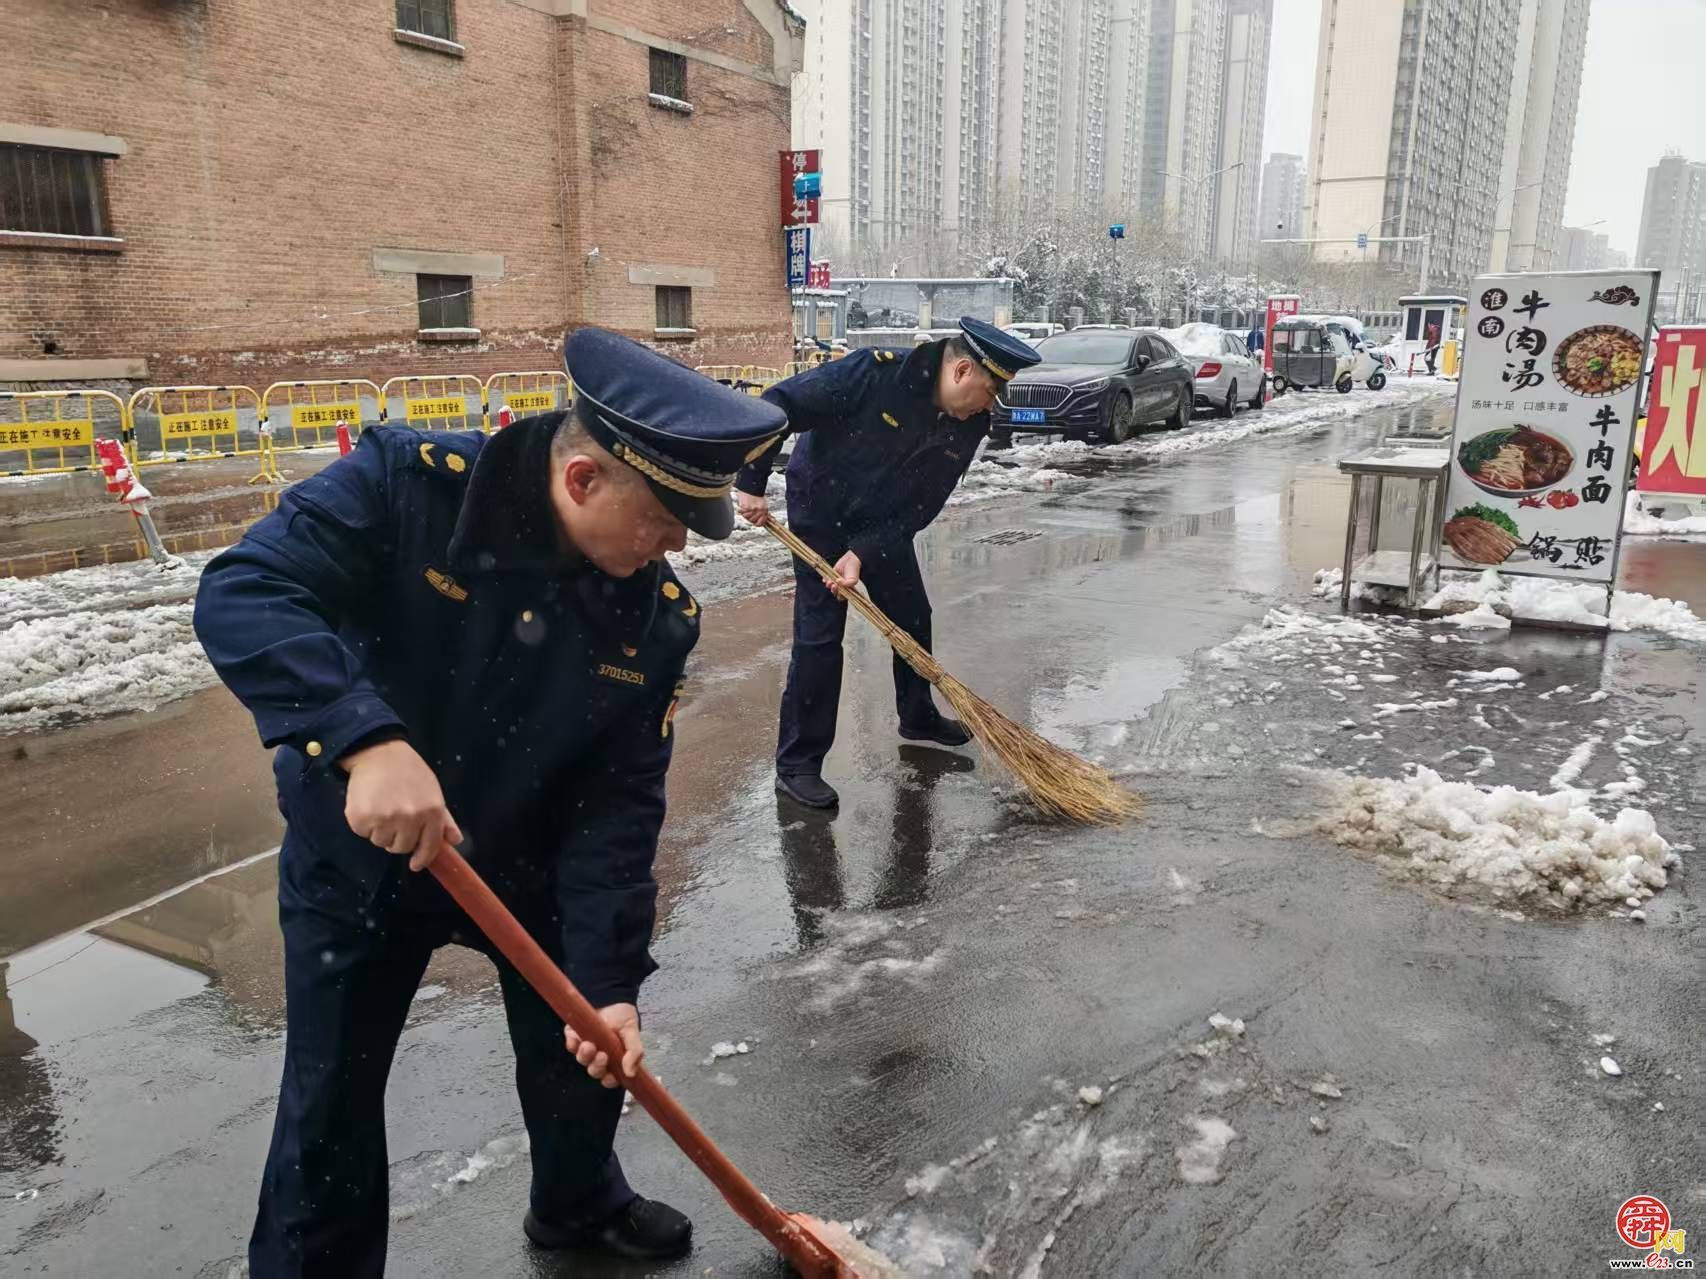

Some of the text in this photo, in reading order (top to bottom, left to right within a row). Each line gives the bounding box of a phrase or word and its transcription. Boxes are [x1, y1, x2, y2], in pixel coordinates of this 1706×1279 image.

[1480, 290, 1506, 336] 淮南
[1471, 399, 1568, 413] 汤味十足 口感丰富
[1581, 404, 1621, 505] 牛肉面
[598, 663, 646, 686] 37015251
